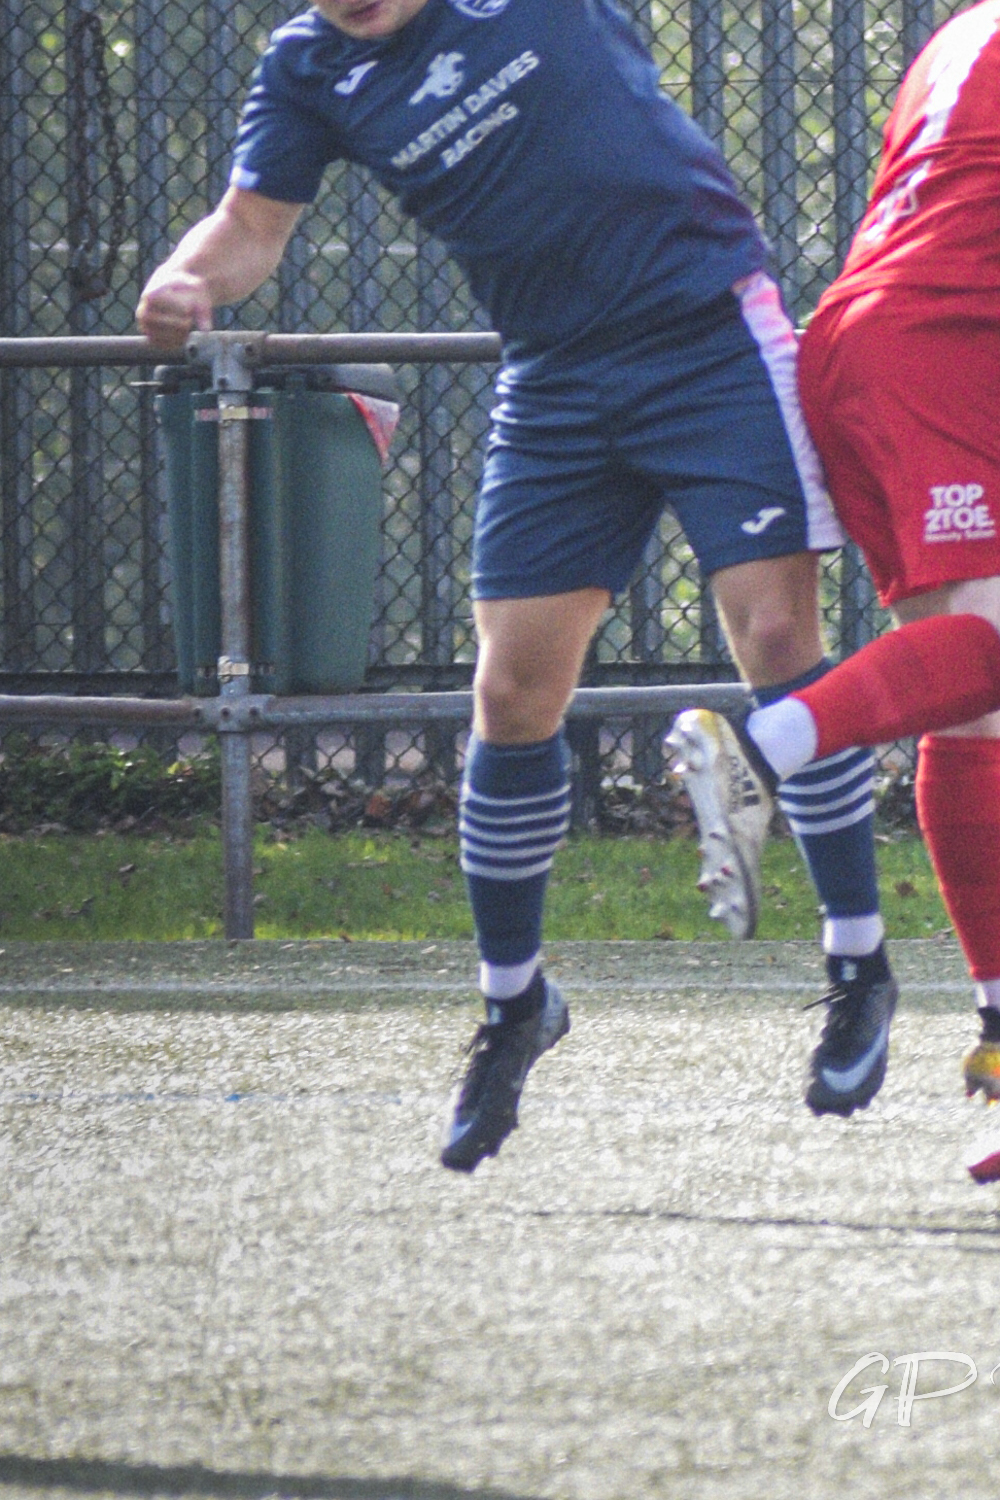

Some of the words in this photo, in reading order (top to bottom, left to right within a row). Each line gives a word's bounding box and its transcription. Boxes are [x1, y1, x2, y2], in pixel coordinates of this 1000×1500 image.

[391, 105, 468, 170] MARTIN
[463, 50, 540, 115] DAVIES
[440, 102, 519, 169] RACING
[930, 483, 984, 509] TOP
